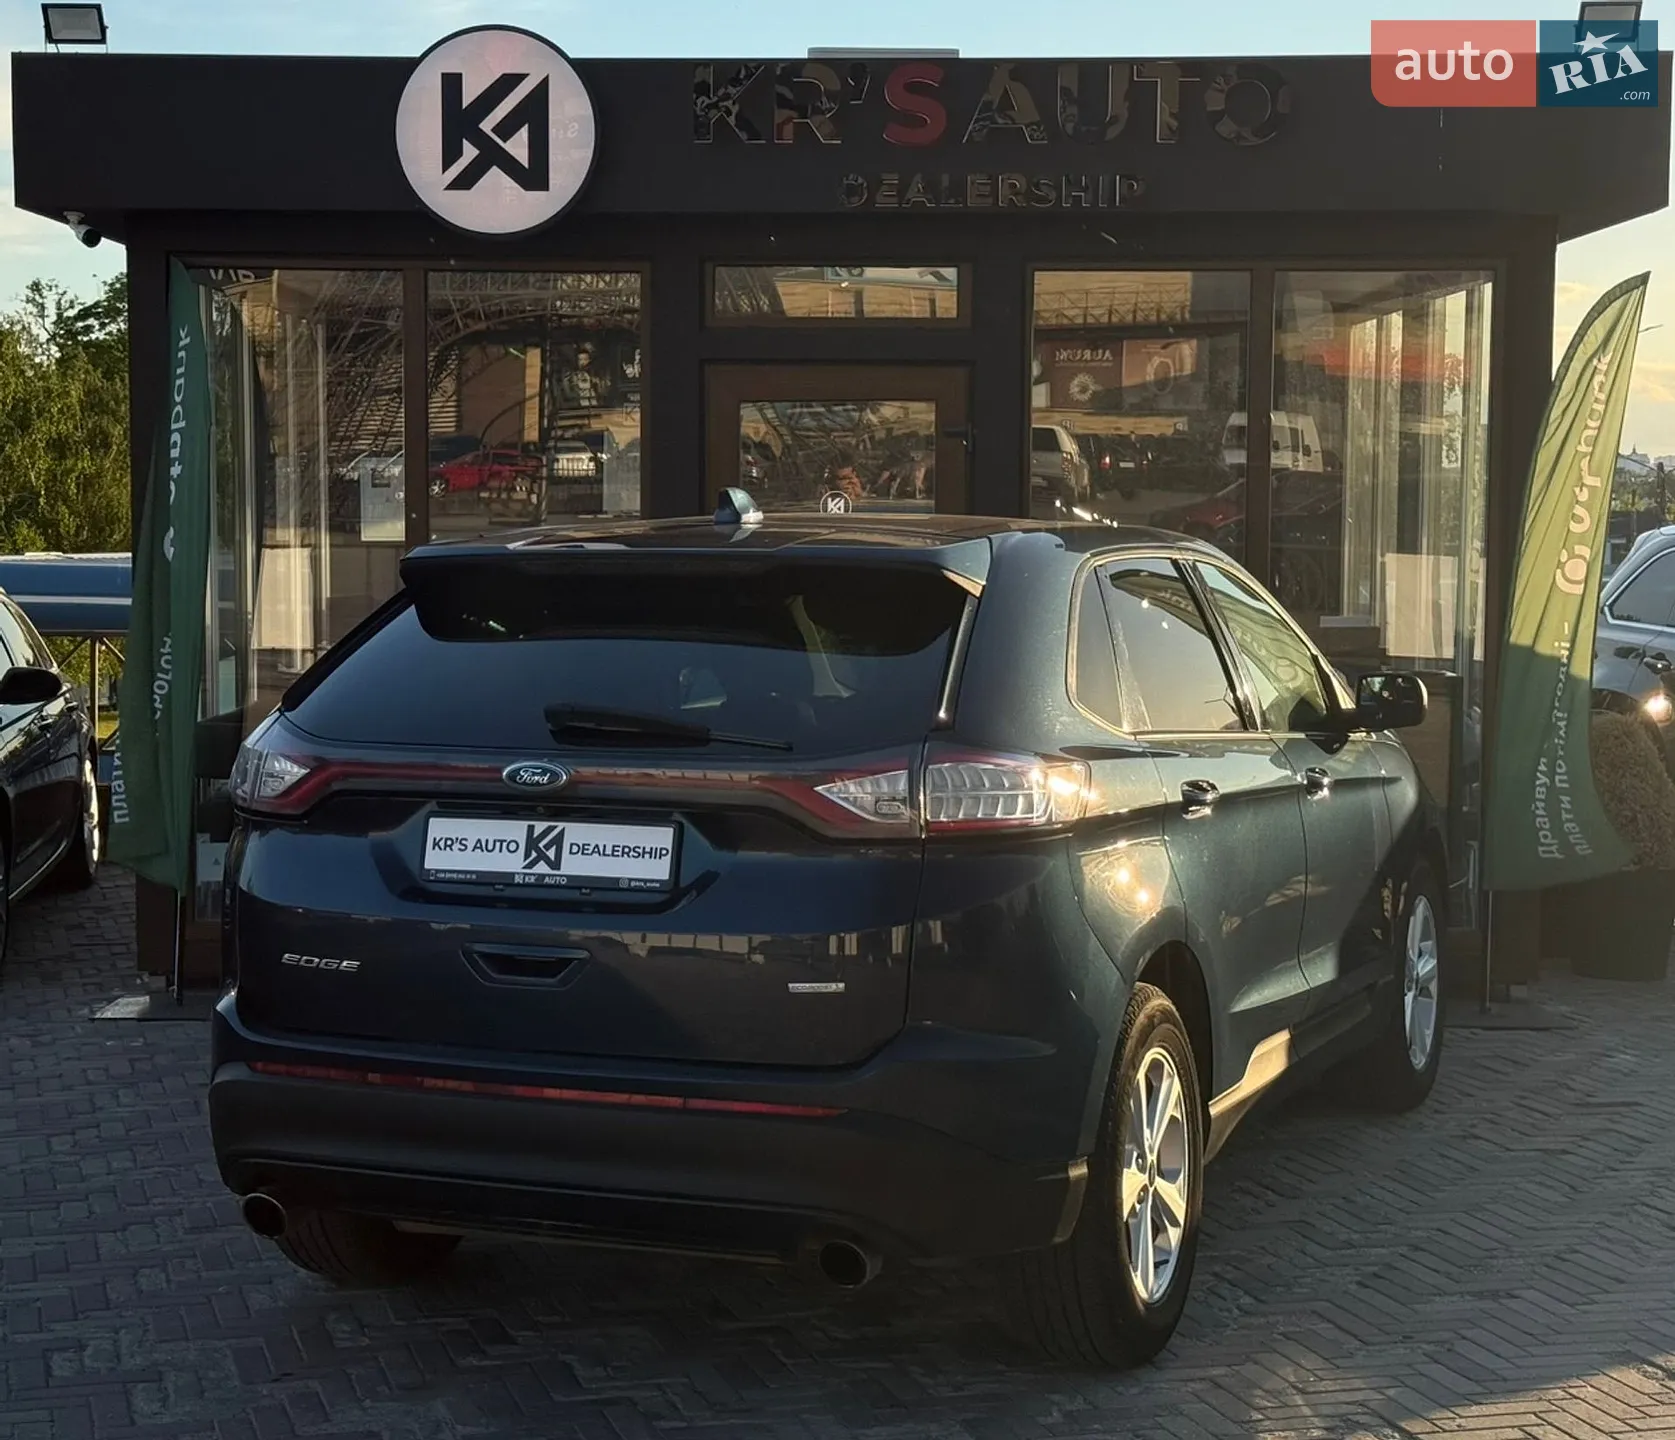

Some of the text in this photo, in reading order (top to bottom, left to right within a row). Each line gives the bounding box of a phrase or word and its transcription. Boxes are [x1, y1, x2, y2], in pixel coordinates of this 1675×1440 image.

[839, 173, 1146, 207] DEALERSHIP
[516, 767, 551, 784] Ford
[431, 836, 469, 853] KR'S
[472, 839, 520, 854] AUTO
[568, 842, 670, 861] DEALERSHIP
[544, 876, 568, 886] AUTO
[281, 953, 361, 972] EDGE
